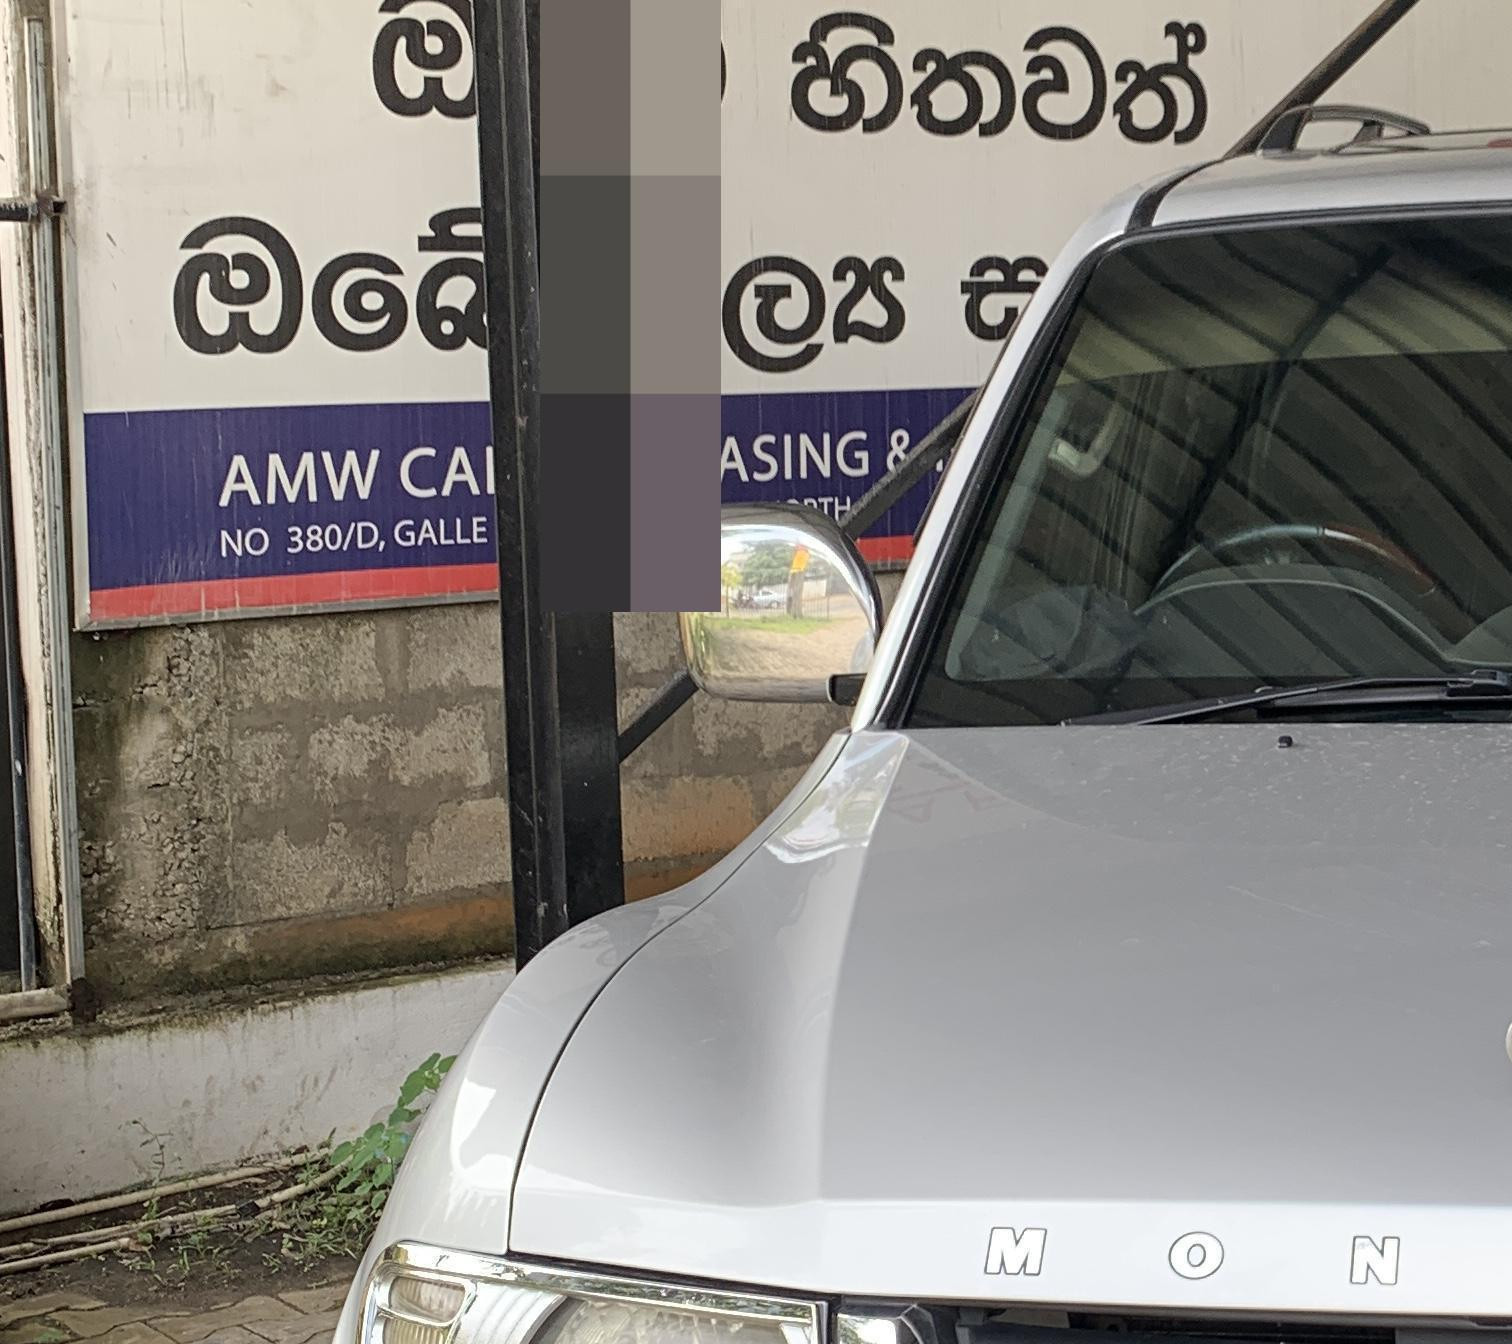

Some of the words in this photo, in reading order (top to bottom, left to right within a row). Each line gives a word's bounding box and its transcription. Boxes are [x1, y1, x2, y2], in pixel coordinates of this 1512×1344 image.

[790, 12, 1208, 144] හිතවත්
[219, 449, 380, 507] AMW
[721, 430, 870, 483] ASING
[220, 528, 269, 558] NO
[287, 522, 385, 554] 380/D,
[394, 516, 488, 547] GALLE
